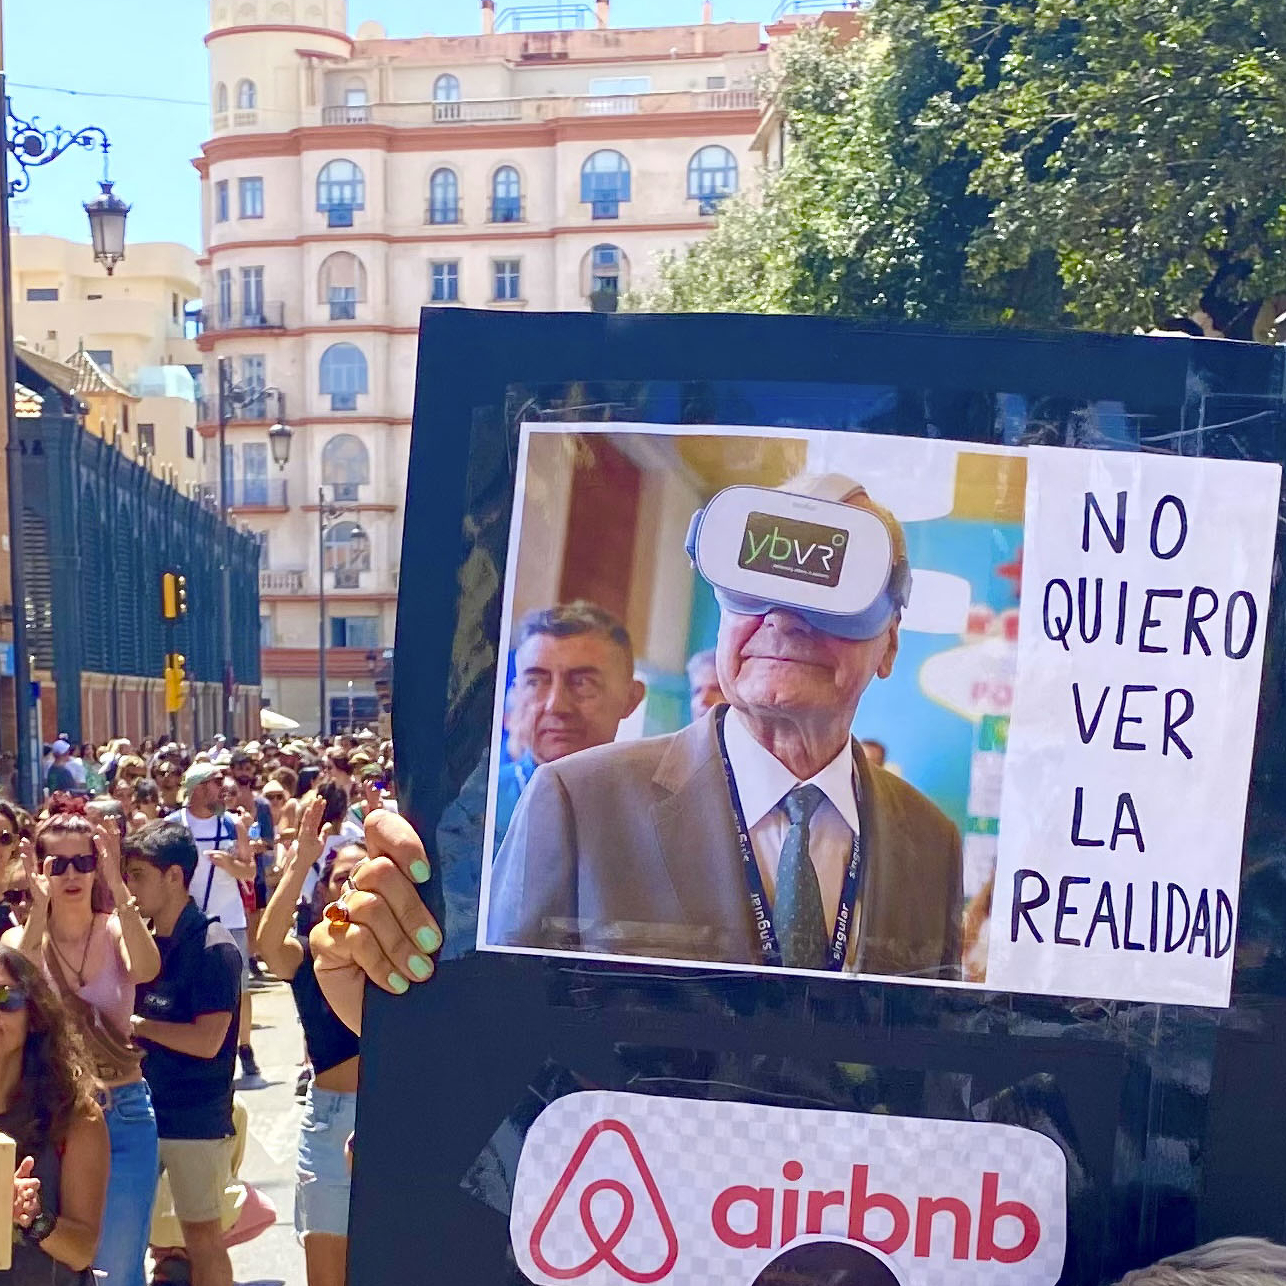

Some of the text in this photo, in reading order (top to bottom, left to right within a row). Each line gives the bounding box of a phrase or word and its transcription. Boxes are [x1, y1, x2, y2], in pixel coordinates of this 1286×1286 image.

[1080, 490, 1188, 560] NO
[1041, 577, 1259, 661] QUIERO
[1072, 682, 1195, 761] VER
[1068, 786, 1146, 854] LA
[832, 902, 852, 960] singular
[1009, 868, 1235, 959] REALIDAD
[711, 1160, 1041, 1264] airbnb
